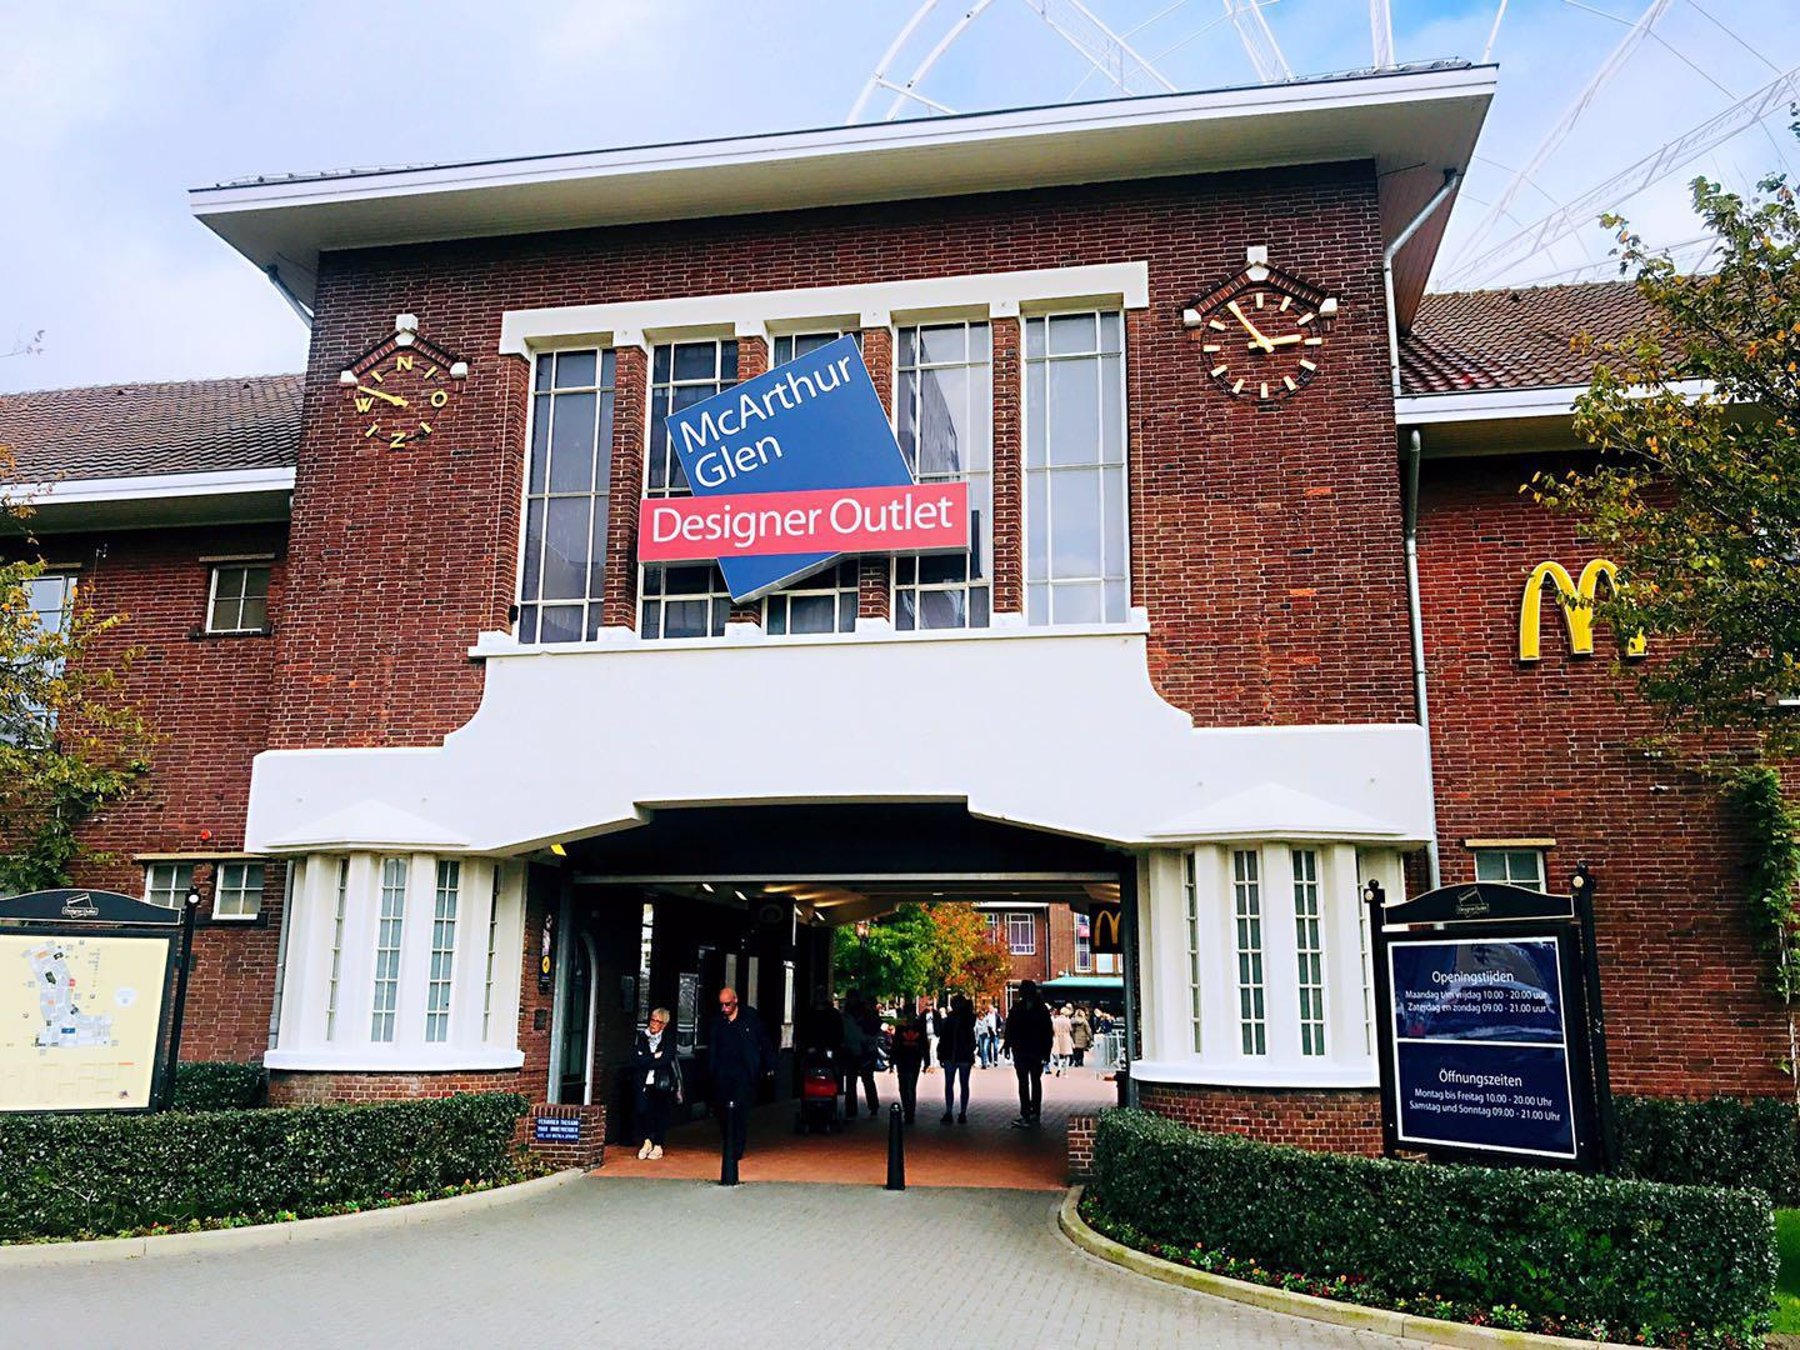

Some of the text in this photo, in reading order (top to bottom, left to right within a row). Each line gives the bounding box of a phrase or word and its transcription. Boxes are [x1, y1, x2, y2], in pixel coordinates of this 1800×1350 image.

[396, 355, 413, 372] N
[355, 397, 375, 413] W
[679, 355, 851, 453] McArthur
[694, 434, 784, 489] Glen
[651, 493, 953, 550] Designer Outlet
[1431, 970, 1515, 986] Openingstijden
[1405, 990, 1439, 1000] Maandag
[1483, 990, 1504, 1000] 10.00
[1509, 990, 1532, 1000] 20.00
[1407, 1002, 1441, 1013] Zaterdag
[1452, 1003, 1481, 1013] zondag
[1481, 1003, 1504, 1012] 09.00
[1509, 1003, 1532, 1013] 21.00
[1532, 1005, 1547, 1013] uur
[1438, 1068, 1523, 1088] Öffnungszeiten
[1414, 1088, 1444, 1100] Montag
[1444, 1090, 1456, 1099] bis
[1457, 1091, 1484, 1104] Freitag
[1485, 1093, 1507, 1104] 10.00
[1513, 1095, 1536, 1106] 20.00
[1536, 1097, 1552, 1107] Uhr
[1409, 1100, 1441, 1113] Samstag
[1441, 1103, 1457, 1113] und
[1458, 1104, 1491, 1118] Sonntag
[1492, 1107, 1515, 1117] 09.00
[1521, 1109, 1544, 1120] 21.00
[1544, 1111, 1561, 1121] Uhr
